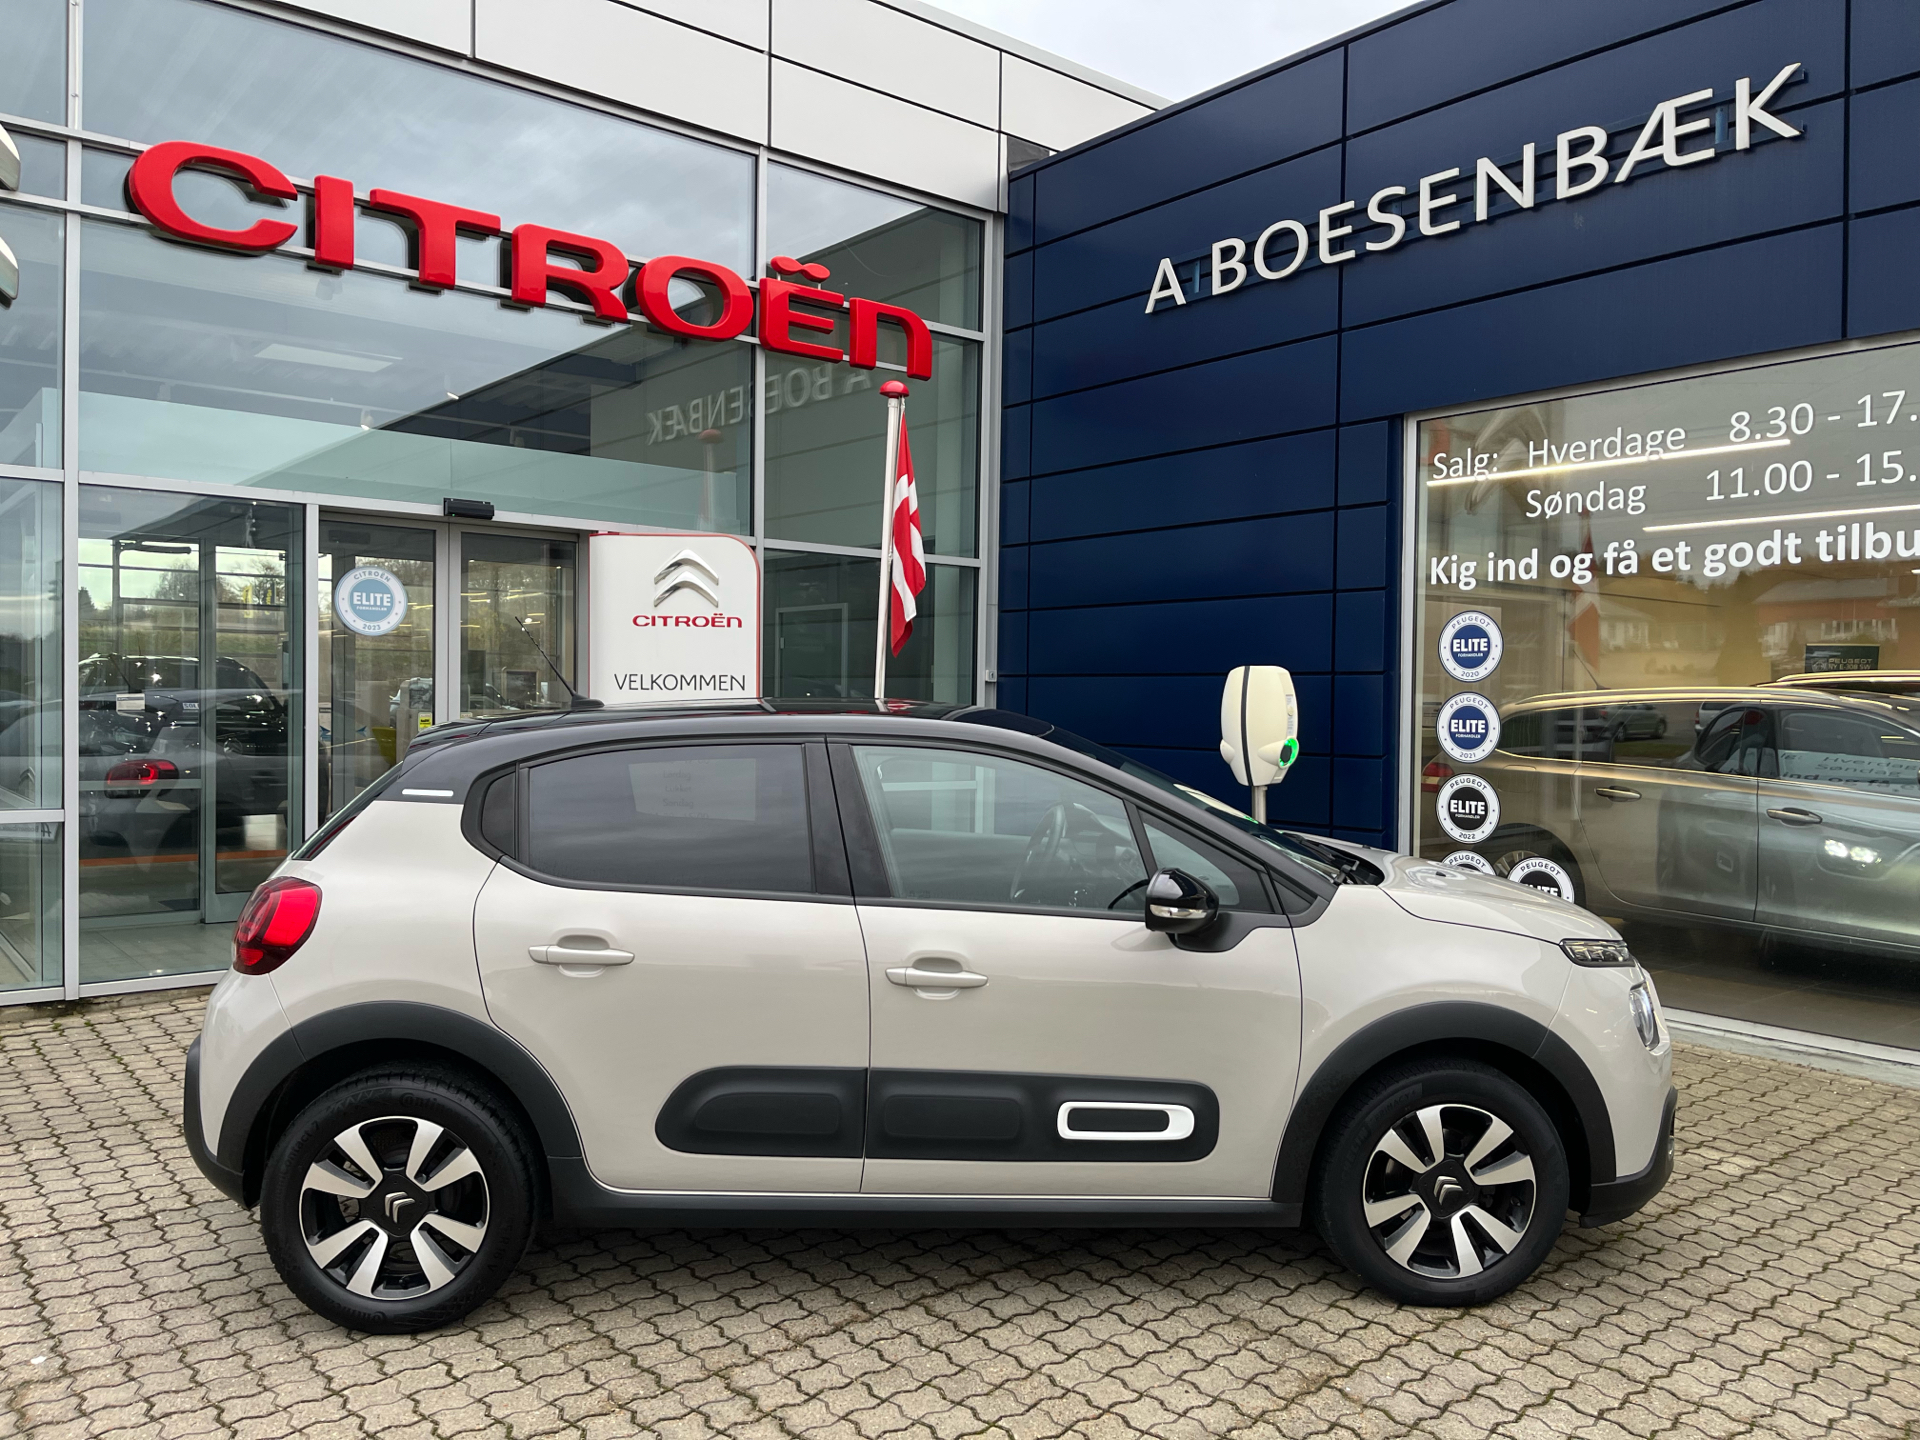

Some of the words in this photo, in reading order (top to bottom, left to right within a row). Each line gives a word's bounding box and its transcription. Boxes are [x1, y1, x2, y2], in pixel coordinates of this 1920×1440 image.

[1145, 257, 1187, 315] A
[1210, 62, 1801, 296] BOESENBÆK
[127, 140, 933, 381] CITROËN
[1432, 448, 1498, 482] Salg:
[1528, 427, 1687, 468] Hverdage
[1729, 402, 1814, 443] 8.30
[1525, 480, 1647, 519] Søndag
[1706, 460, 1813, 501] 11.00
[1430, 554, 1477, 591] Kig
[1487, 548, 1539, 582] ind
[1549, 551, 1593, 584] og
[1603, 539, 1639, 575] få
[1651, 541, 1691, 572] et
[1702, 529, 1802, 577] godt
[354, 571, 390, 582] CITROËN
[353, 592, 391, 606] ELITE
[632, 613, 742, 628] CITROËN
[1451, 615, 1491, 630] PEUGEOT
[1452, 637, 1489, 652] ELITE
[1461, 670, 1480, 678] 2020
[613, 673, 746, 691] VELKOMMEN
[1449, 696, 1489, 710] PEUGEOT
[1450, 719, 1486, 733] ELITE
[1449, 777, 1488, 791] PEUGEOT
[1450, 800, 1485, 814] ELITE
[1458, 831, 1476, 840] 2022
[1448, 854, 1487, 869] PEUGEOT
[1520, 861, 1561, 876] PEUGEOT
